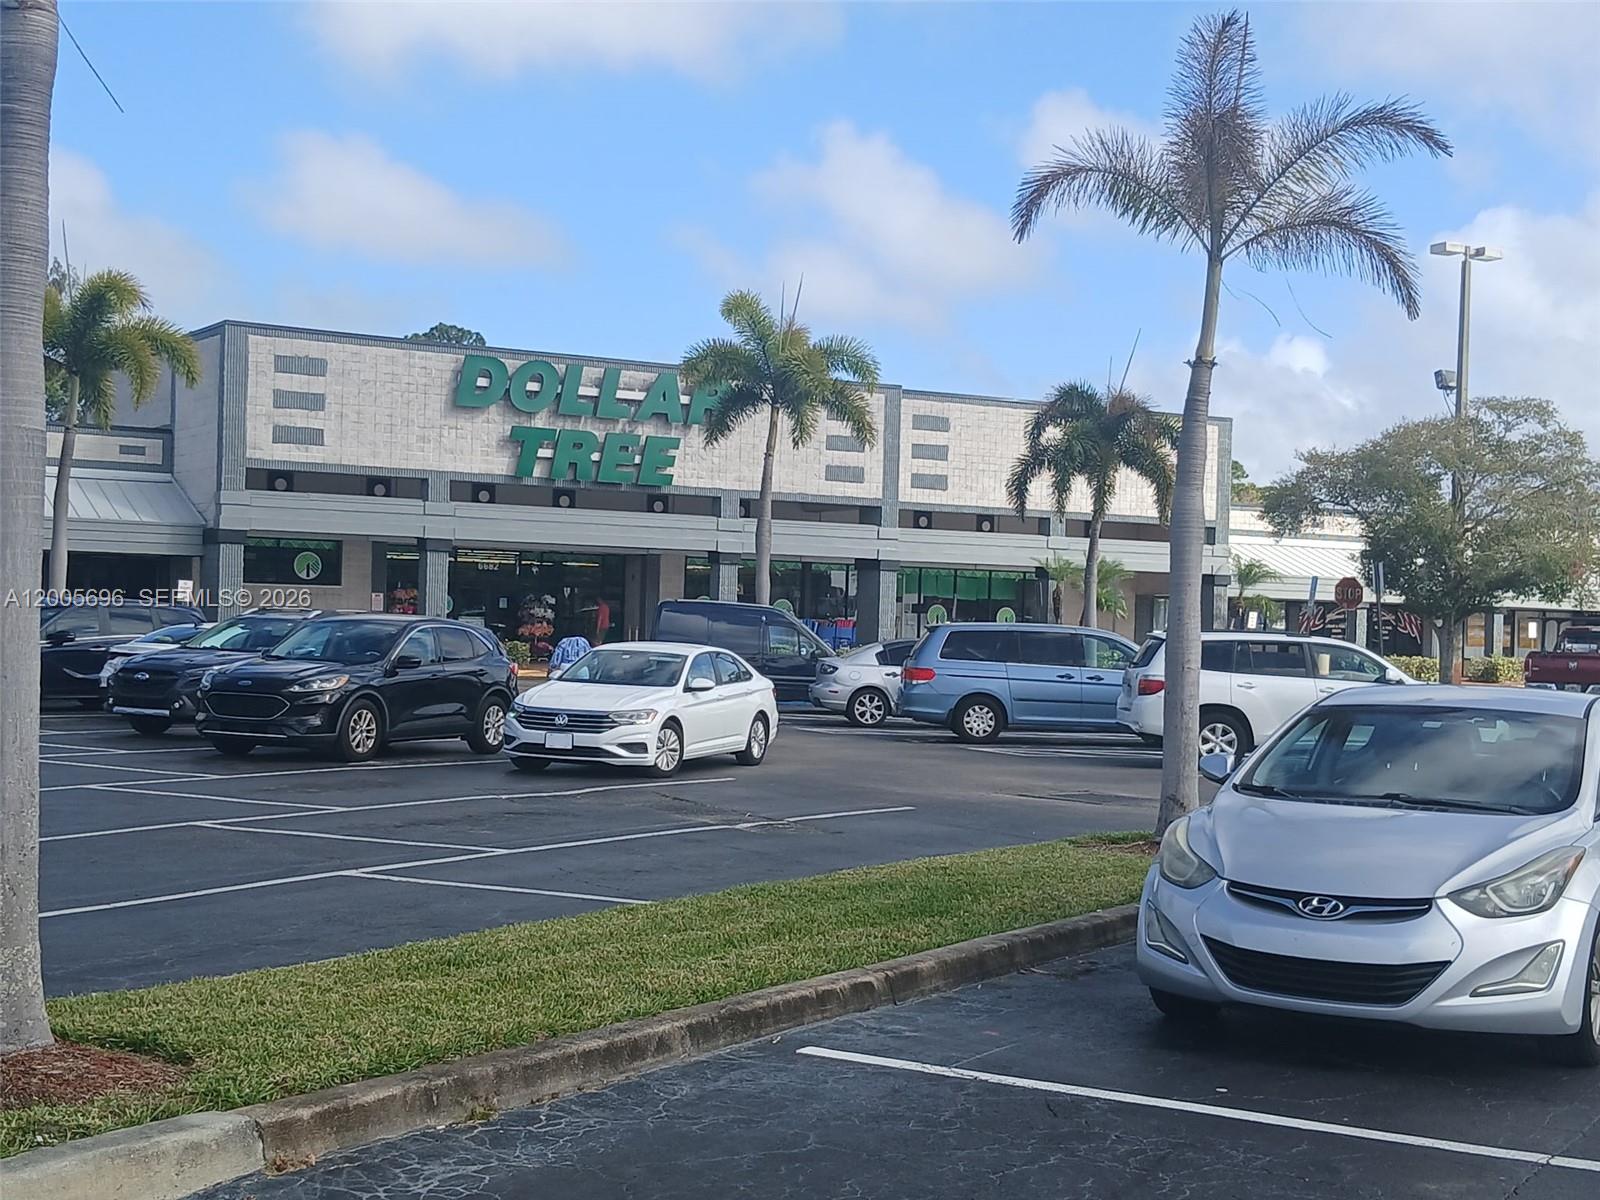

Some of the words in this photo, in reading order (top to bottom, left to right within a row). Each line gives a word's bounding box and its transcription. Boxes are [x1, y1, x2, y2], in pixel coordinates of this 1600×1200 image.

[455, 354, 734, 425] DOLLAR
[510, 425, 681, 486] TREE
[1336, 586, 1362, 600] STOP
